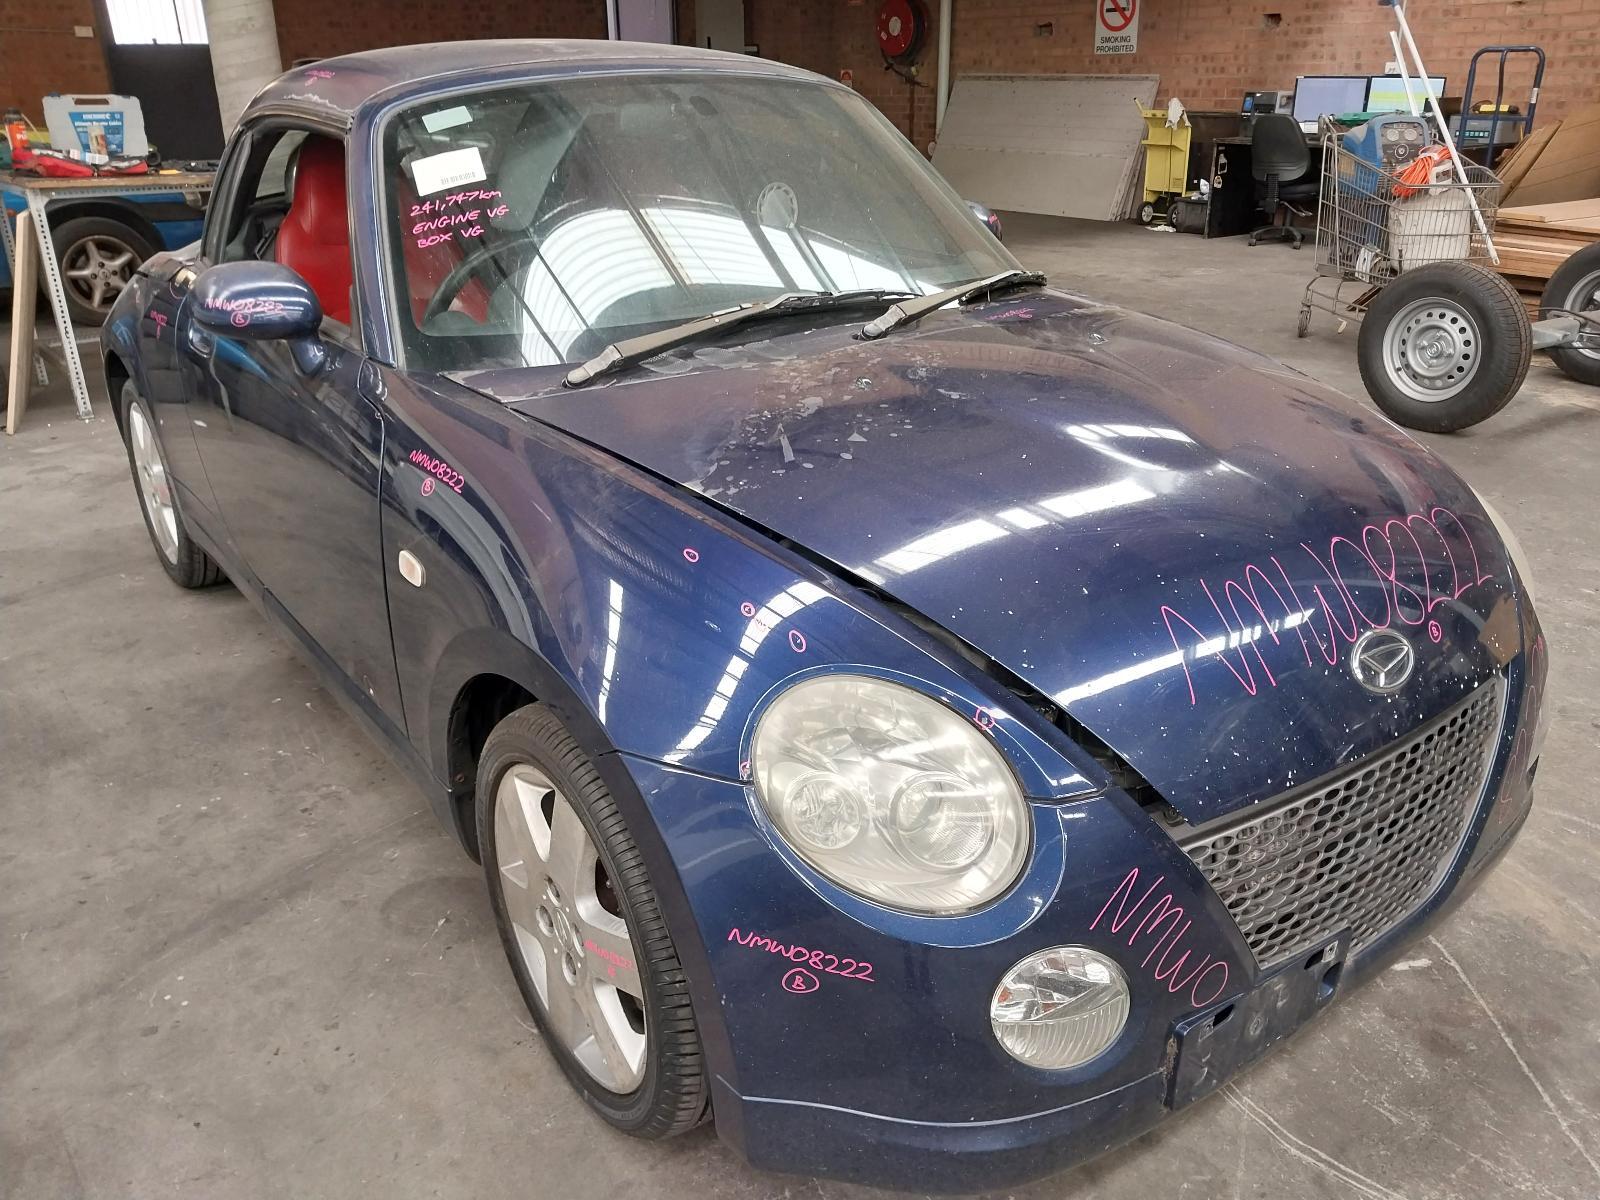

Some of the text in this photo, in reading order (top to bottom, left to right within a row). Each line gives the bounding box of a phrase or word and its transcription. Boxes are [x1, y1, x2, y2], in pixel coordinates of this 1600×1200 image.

[1096, 45, 1135, 53] PROHIBITED
[1101, 36, 1131, 44] SMOKING
[412, 205, 509, 234] ENGINE VG
[417, 226, 484, 248] BOX VG
[410, 449, 464, 493] NMW08222
[1160, 507, 1493, 705] NMW08222
[727, 927, 876, 982] NMW08222
